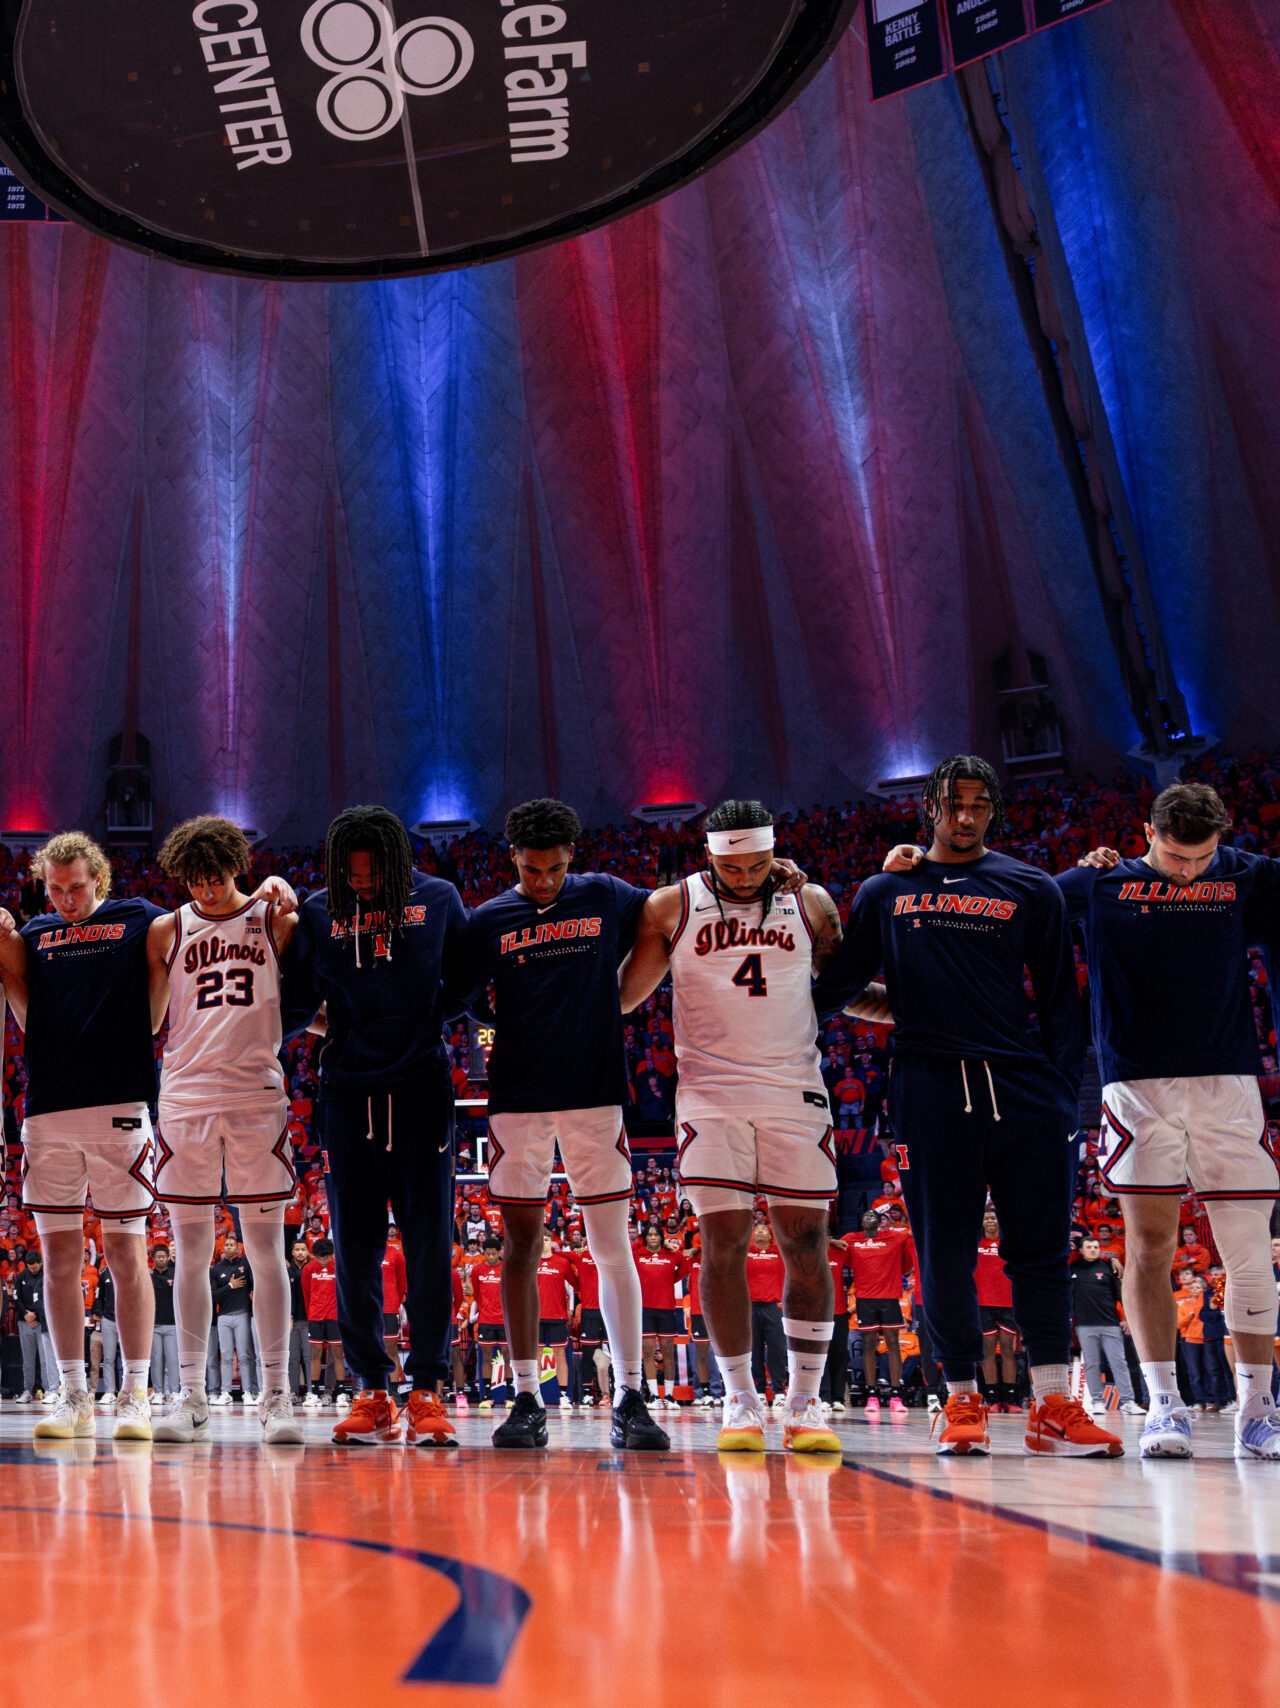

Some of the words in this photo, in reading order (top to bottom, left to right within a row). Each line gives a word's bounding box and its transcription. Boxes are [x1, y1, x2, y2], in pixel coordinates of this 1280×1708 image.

[884, 22, 922, 47] BATTLE
[885, 12, 919, 35] KENNY
[192, 0, 293, 171] CENTER
[499, 0, 589, 163] eFarm
[893, 893, 1017, 920] ILLINOIS
[1118, 882, 1236, 902] ILLINOIS
[35, 924, 125, 951] ILLINOIS
[330, 905, 427, 937] ILLINIS
[500, 917, 601, 955] ILLINOIS
[694, 917, 796, 956] Illinois
[183, 936, 267, 975] Illinois
[195, 968, 255, 1010] 23
[731, 953, 769, 997] 4
